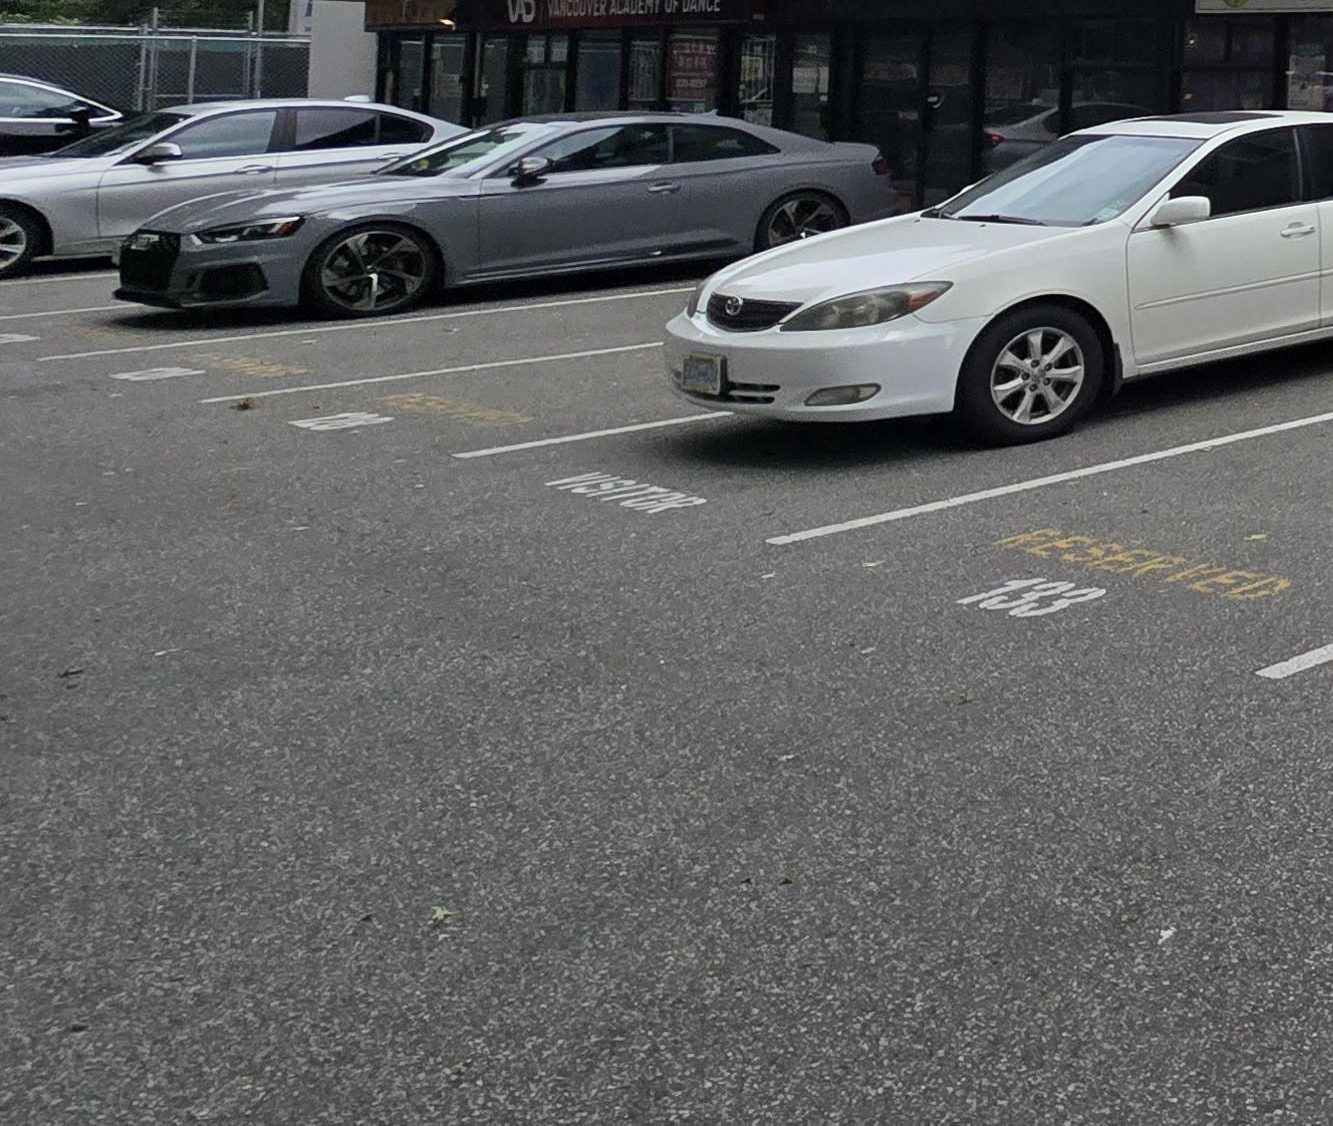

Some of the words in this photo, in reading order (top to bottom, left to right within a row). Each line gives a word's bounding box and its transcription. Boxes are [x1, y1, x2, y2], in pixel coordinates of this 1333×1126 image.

[545, 471, 707, 513] VISITOR
[993, 528, 1292, 600] RESERVED
[956, 577, 1106, 617] 133
